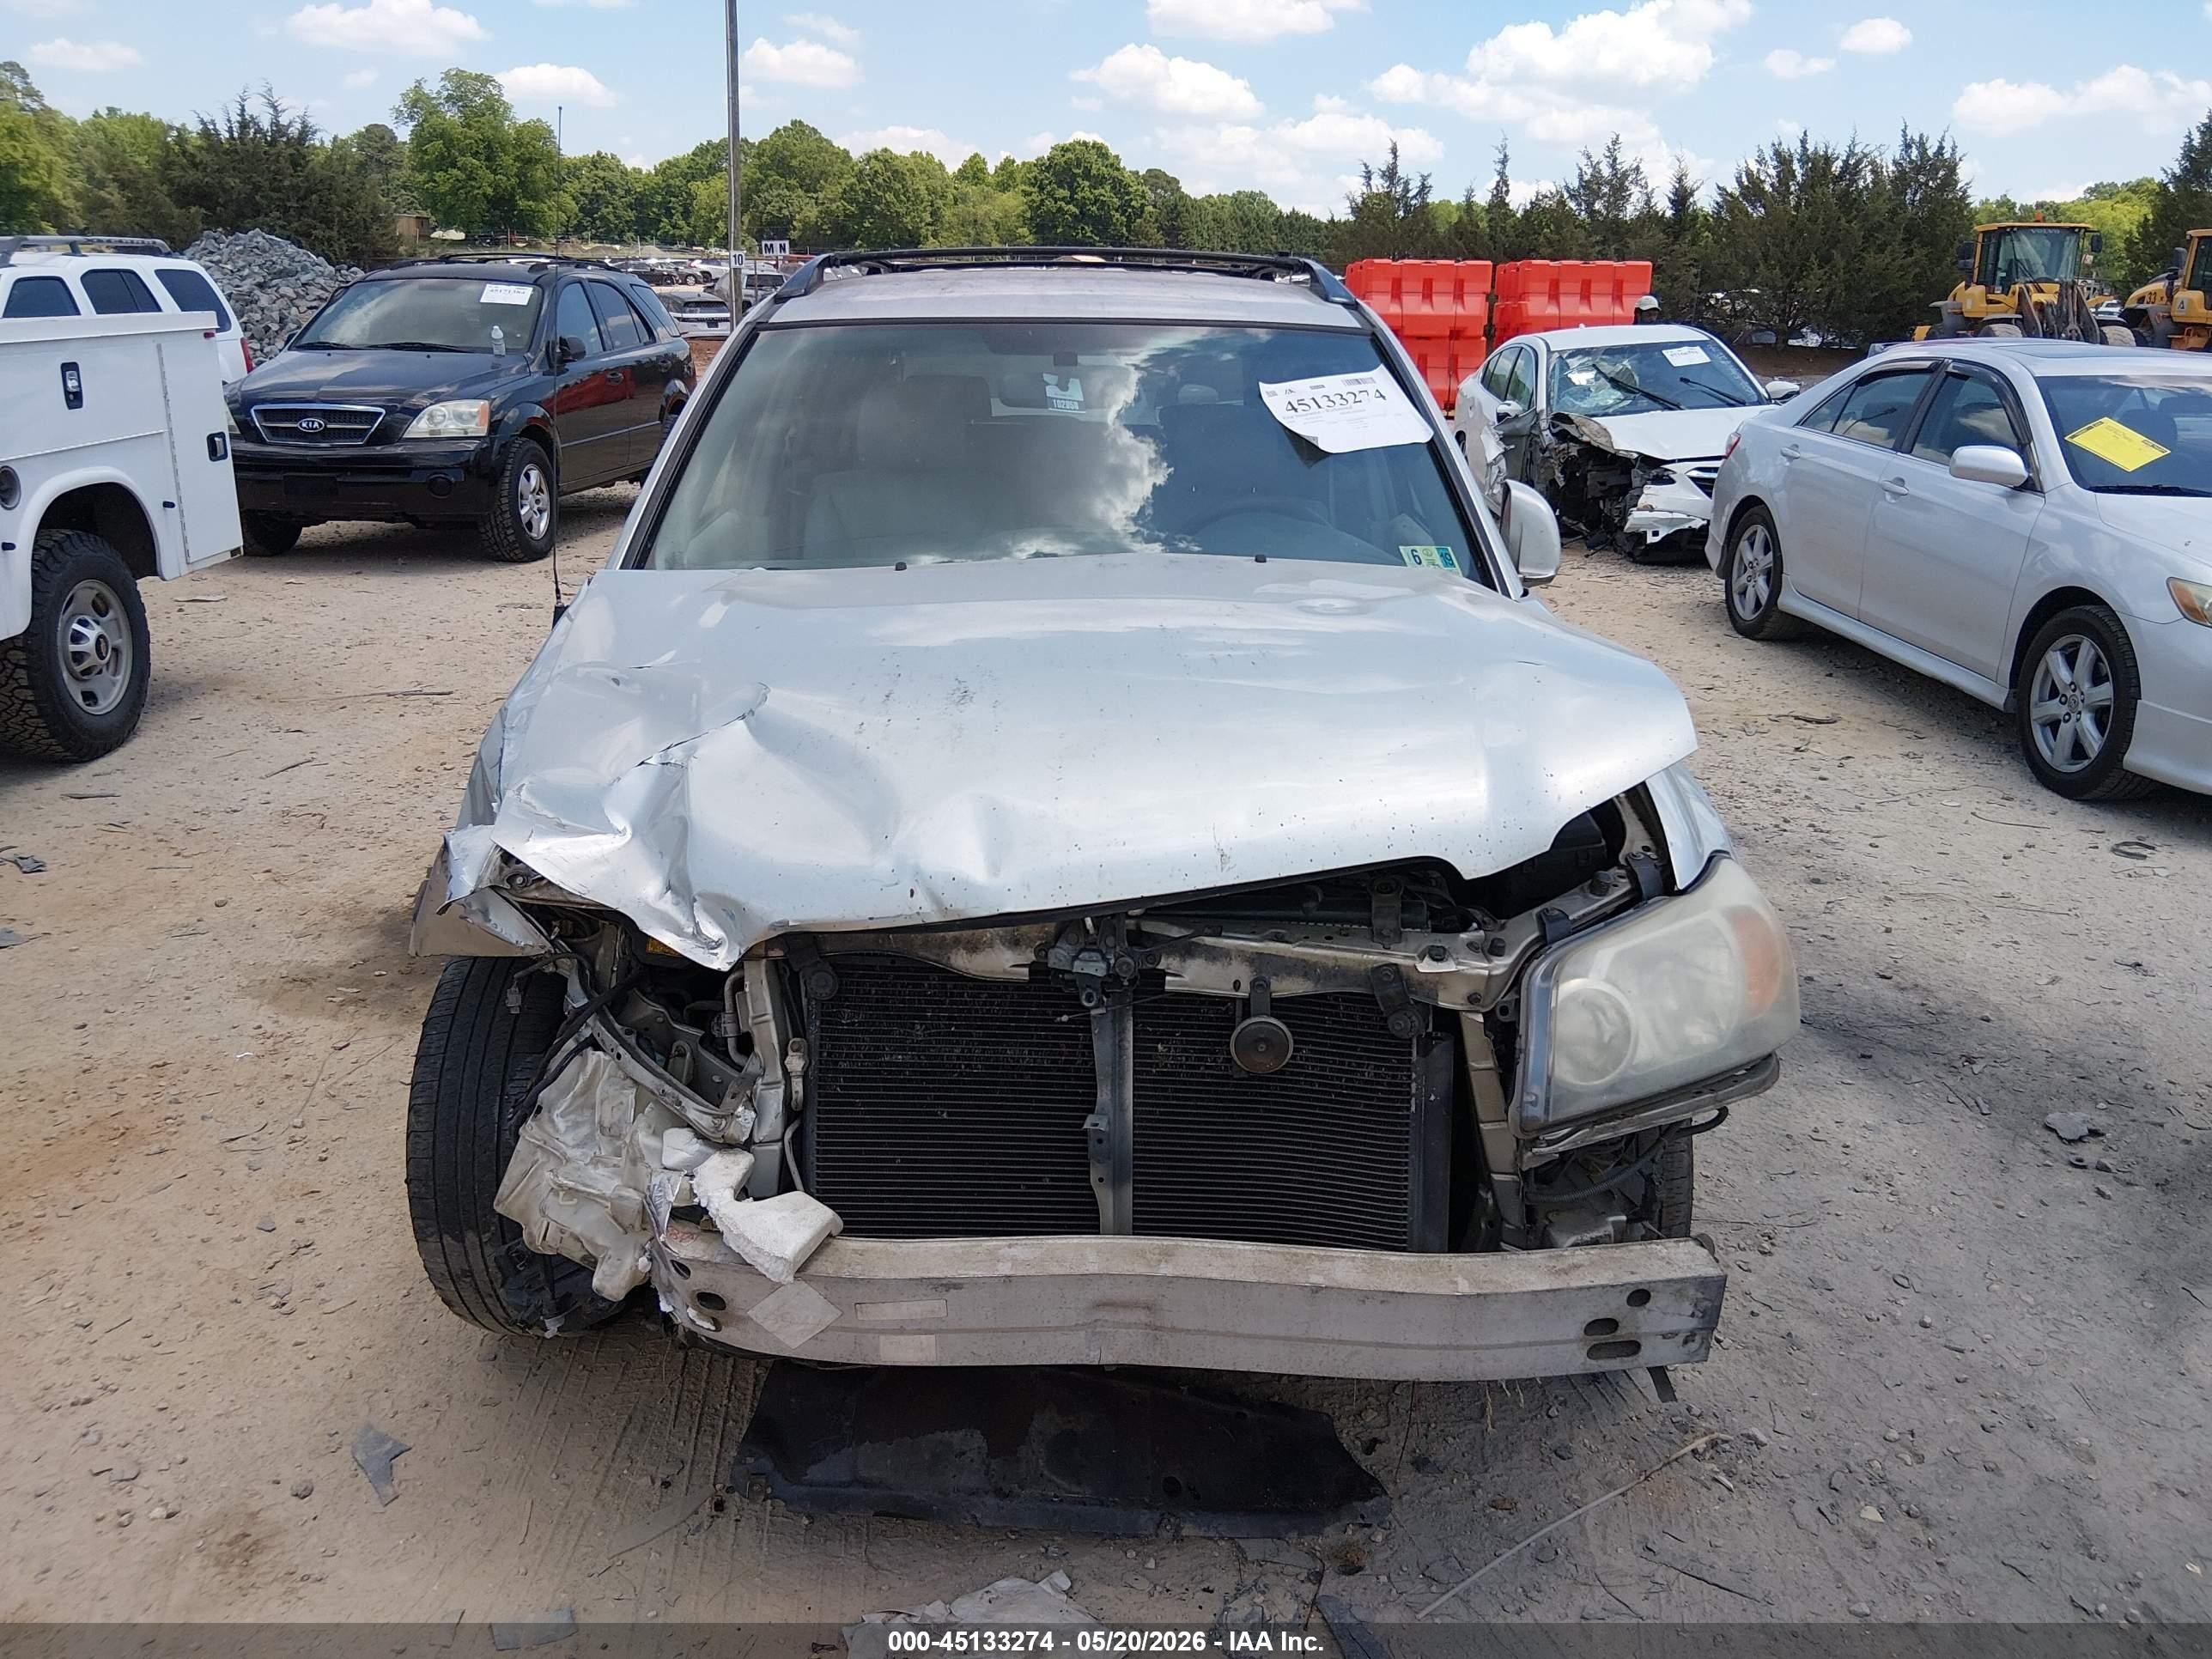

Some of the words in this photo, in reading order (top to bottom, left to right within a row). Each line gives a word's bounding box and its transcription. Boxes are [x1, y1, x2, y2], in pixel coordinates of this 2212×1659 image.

[763, 243, 775, 254] M
[779, 243, 787, 254] N
[732, 253, 744, 266] 10
[2147, 291, 2157, 304] 33
[1285, 388, 1388, 413] 45133274
[301, 421, 319, 429] KIA
[1411, 549, 1423, 566] 6
